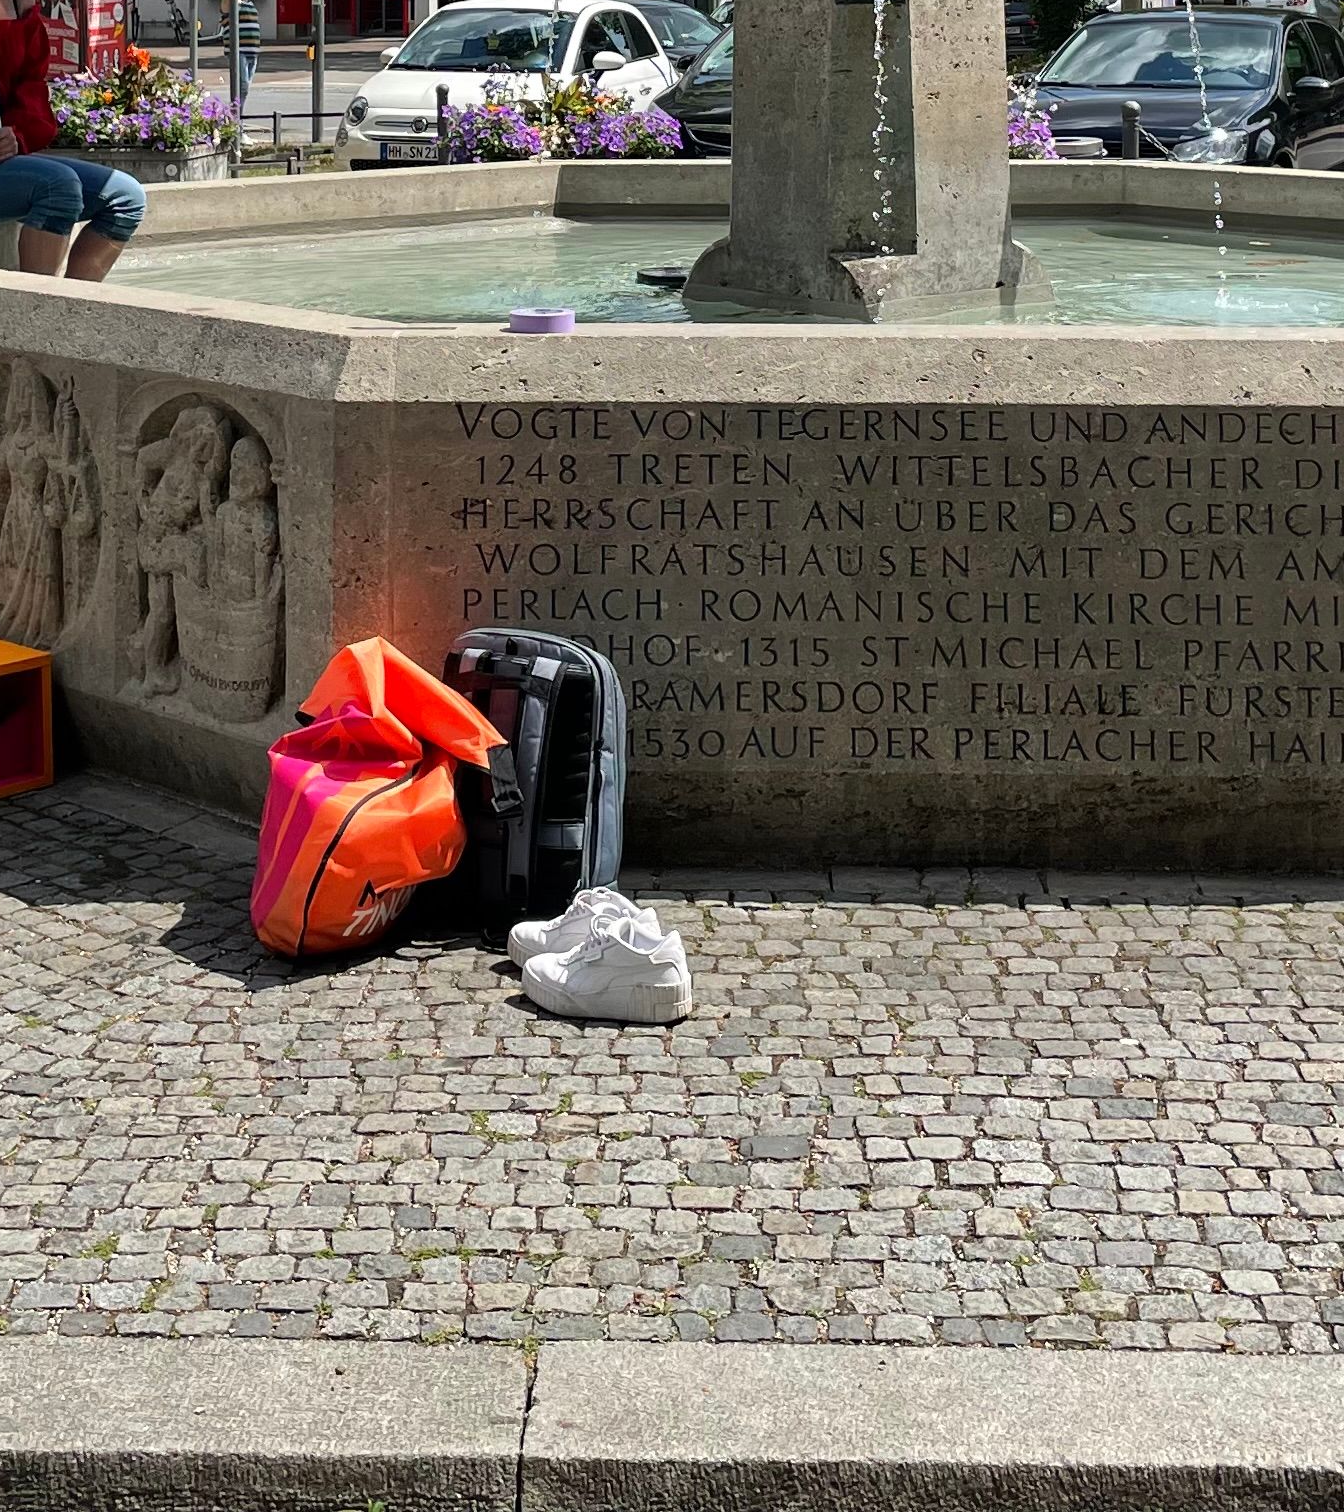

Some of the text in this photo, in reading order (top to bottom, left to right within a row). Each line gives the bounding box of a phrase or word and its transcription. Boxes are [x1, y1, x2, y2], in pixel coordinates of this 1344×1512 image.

[388, 146, 402, 158] HH
[409, 146, 423, 159] SN
[456, 404, 611, 440] VOGTE
[630, 409, 727, 441] VON
[747, 409, 1009, 442] TEGERNSEE
[1030, 411, 1129, 443] UND
[476, 454, 578, 485] 1248
[608, 454, 792, 486] TRETEN
[836, 454, 1264, 489] WITTELSBACHER
[461, 498, 780, 531] HERRSCHAFT
[802, 499, 866, 531] AN
[894, 497, 1019, 533] ÜBER
[1048, 501, 1138, 535] DAS
[476, 543, 970, 579] WOLFRATSHAUSEN
[1009, 546, 1103, 579] MIT
[1139, 548, 1246, 581] DEM
[462, 589, 664, 622] PERLACH
[701, 589, 1043, 624] ROMANISCHE
[1073, 592, 1254, 626] KIRCHE
[740, 636, 830, 667] 1315
[631, 679, 939, 714] RAMERSDORF
[970, 682, 1142, 718] FILIALE
[627, 727, 725, 759] 1530
[739, 727, 826, 759] AUF
[850, 727, 935, 761] DER
[955, 728, 1222, 764] PERLACHER
